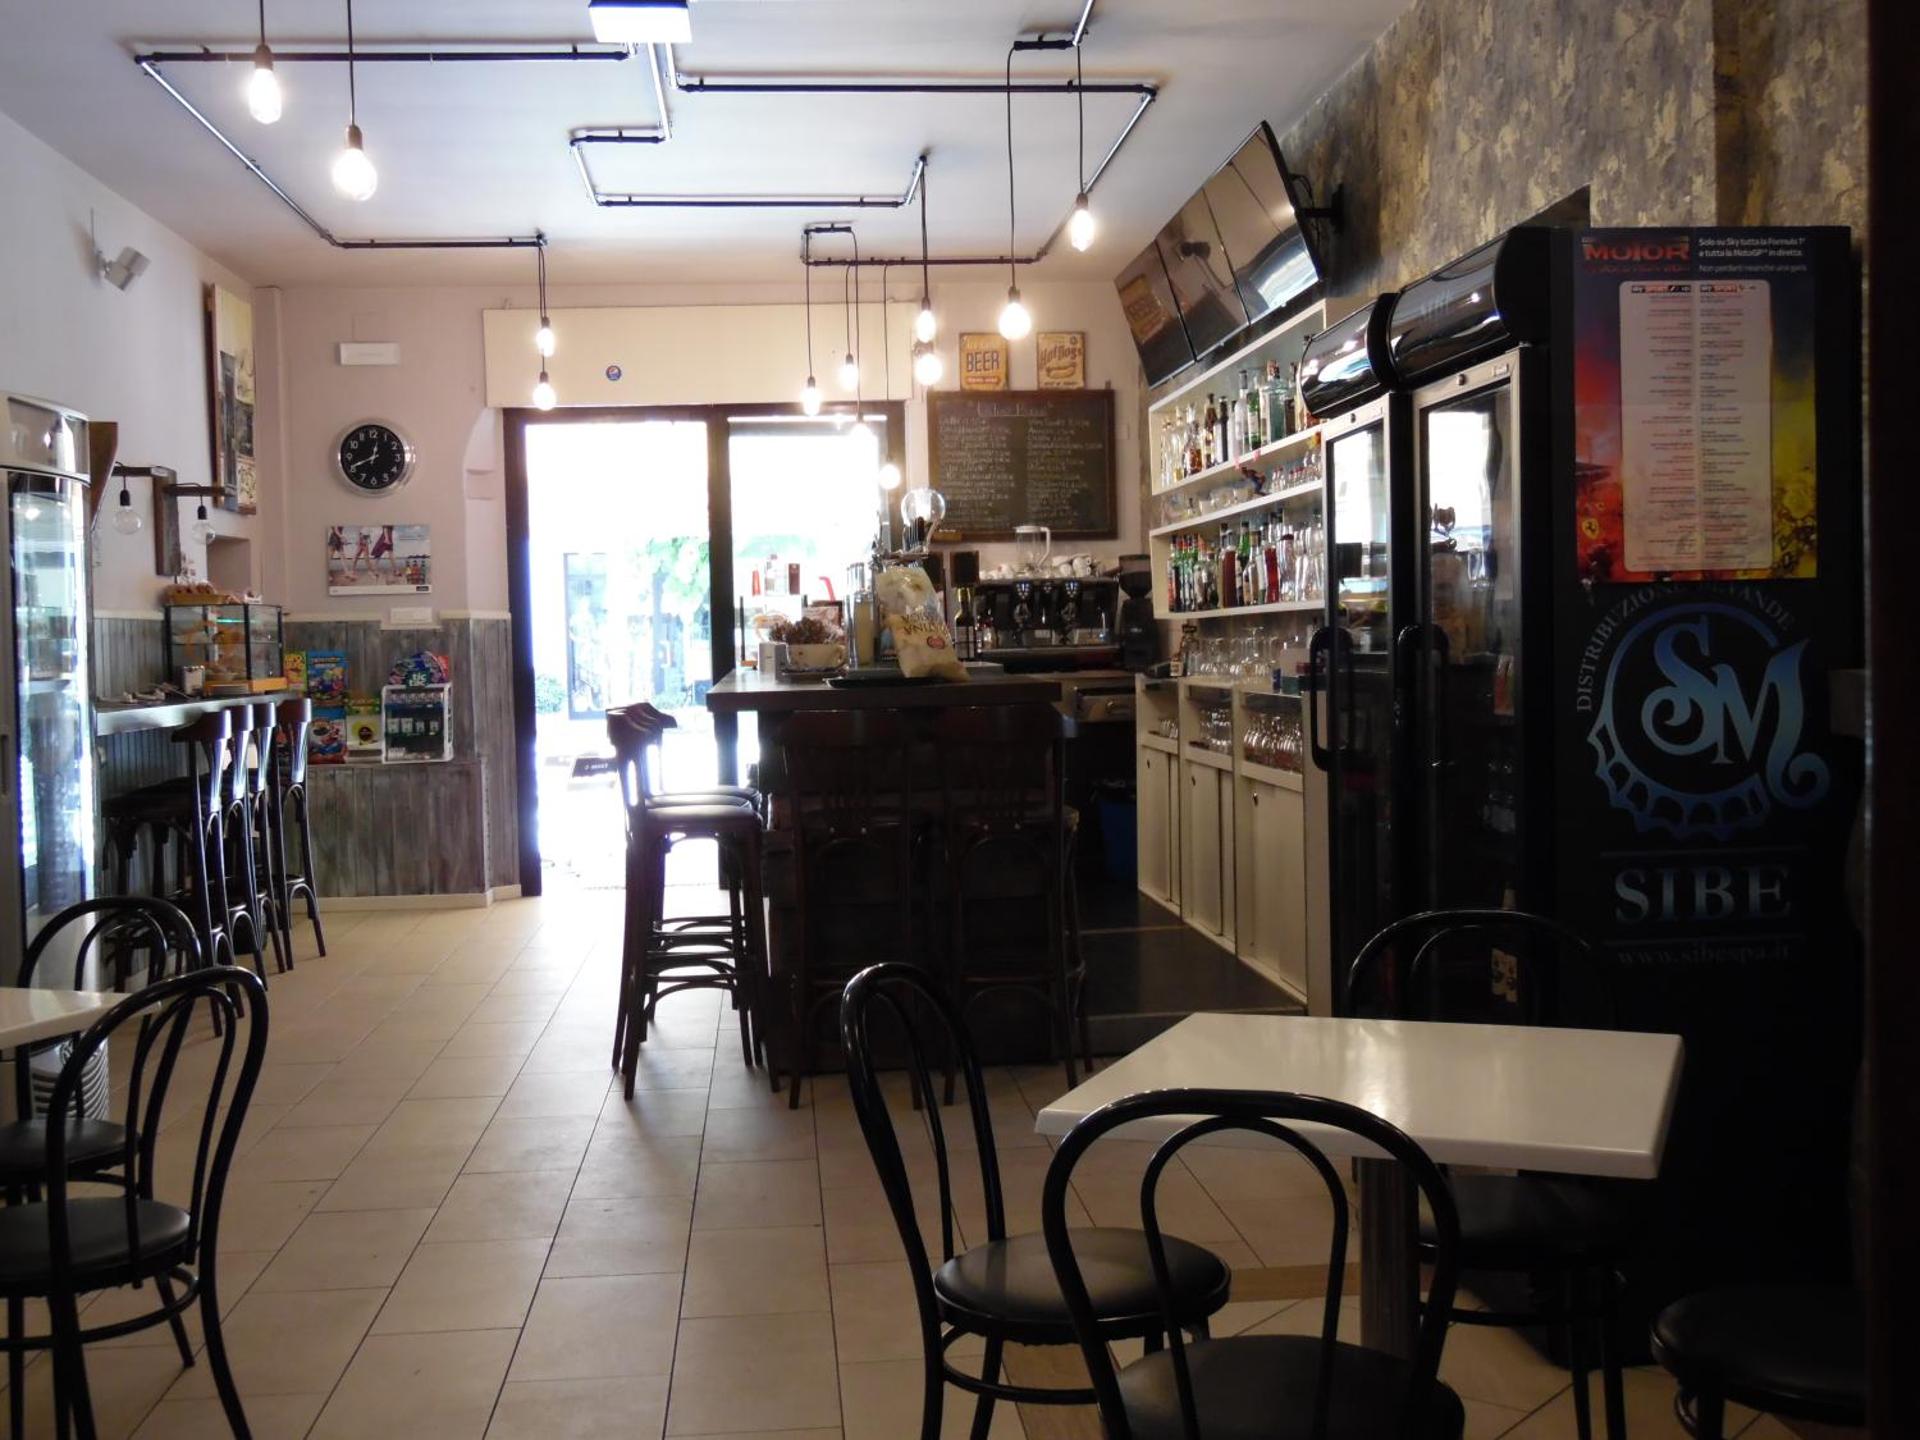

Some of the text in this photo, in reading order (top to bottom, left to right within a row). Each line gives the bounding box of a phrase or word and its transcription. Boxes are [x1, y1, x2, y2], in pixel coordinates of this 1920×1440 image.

[966, 351, 1000, 372] BEER
[369, 430, 377, 438] 12
[384, 432, 387, 440] 1
[350, 440, 358, 449] 10
[391, 442, 398, 450] 2
[346, 453, 352, 461] 9
[395, 453, 400, 462] 3
[360, 474, 366, 482] 7
[370, 476, 376, 485] 6
[384, 473, 388, 482] 5
[412, 671, 426, 681] tic
[1615, 864, 1792, 937] SIBE
